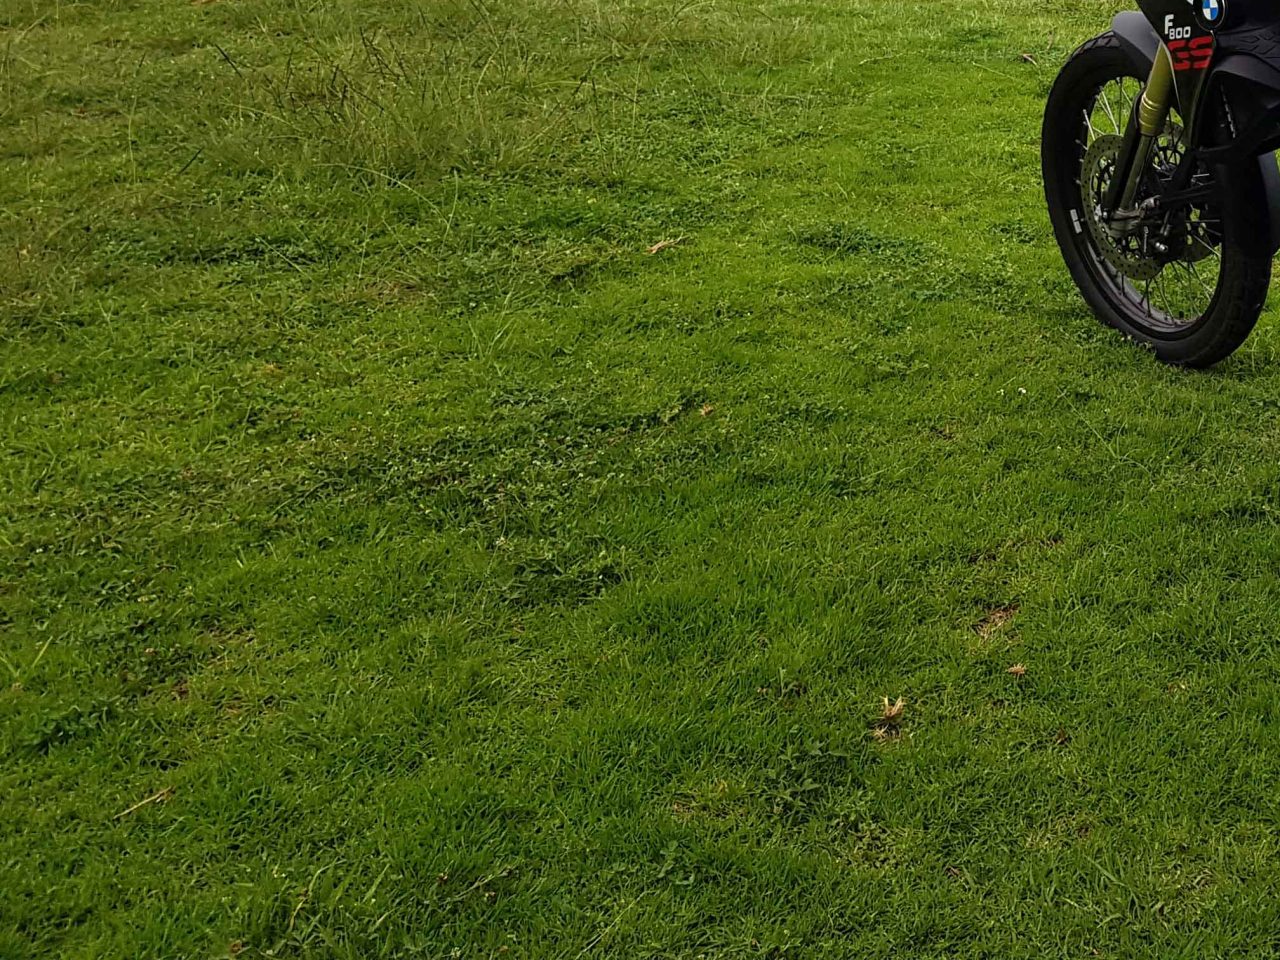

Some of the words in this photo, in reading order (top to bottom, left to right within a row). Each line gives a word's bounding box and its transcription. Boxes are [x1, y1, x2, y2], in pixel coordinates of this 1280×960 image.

[1164, 13, 1175, 35] F
[1169, 26, 1191, 40] 800
[1167, 36, 1214, 71] GS
